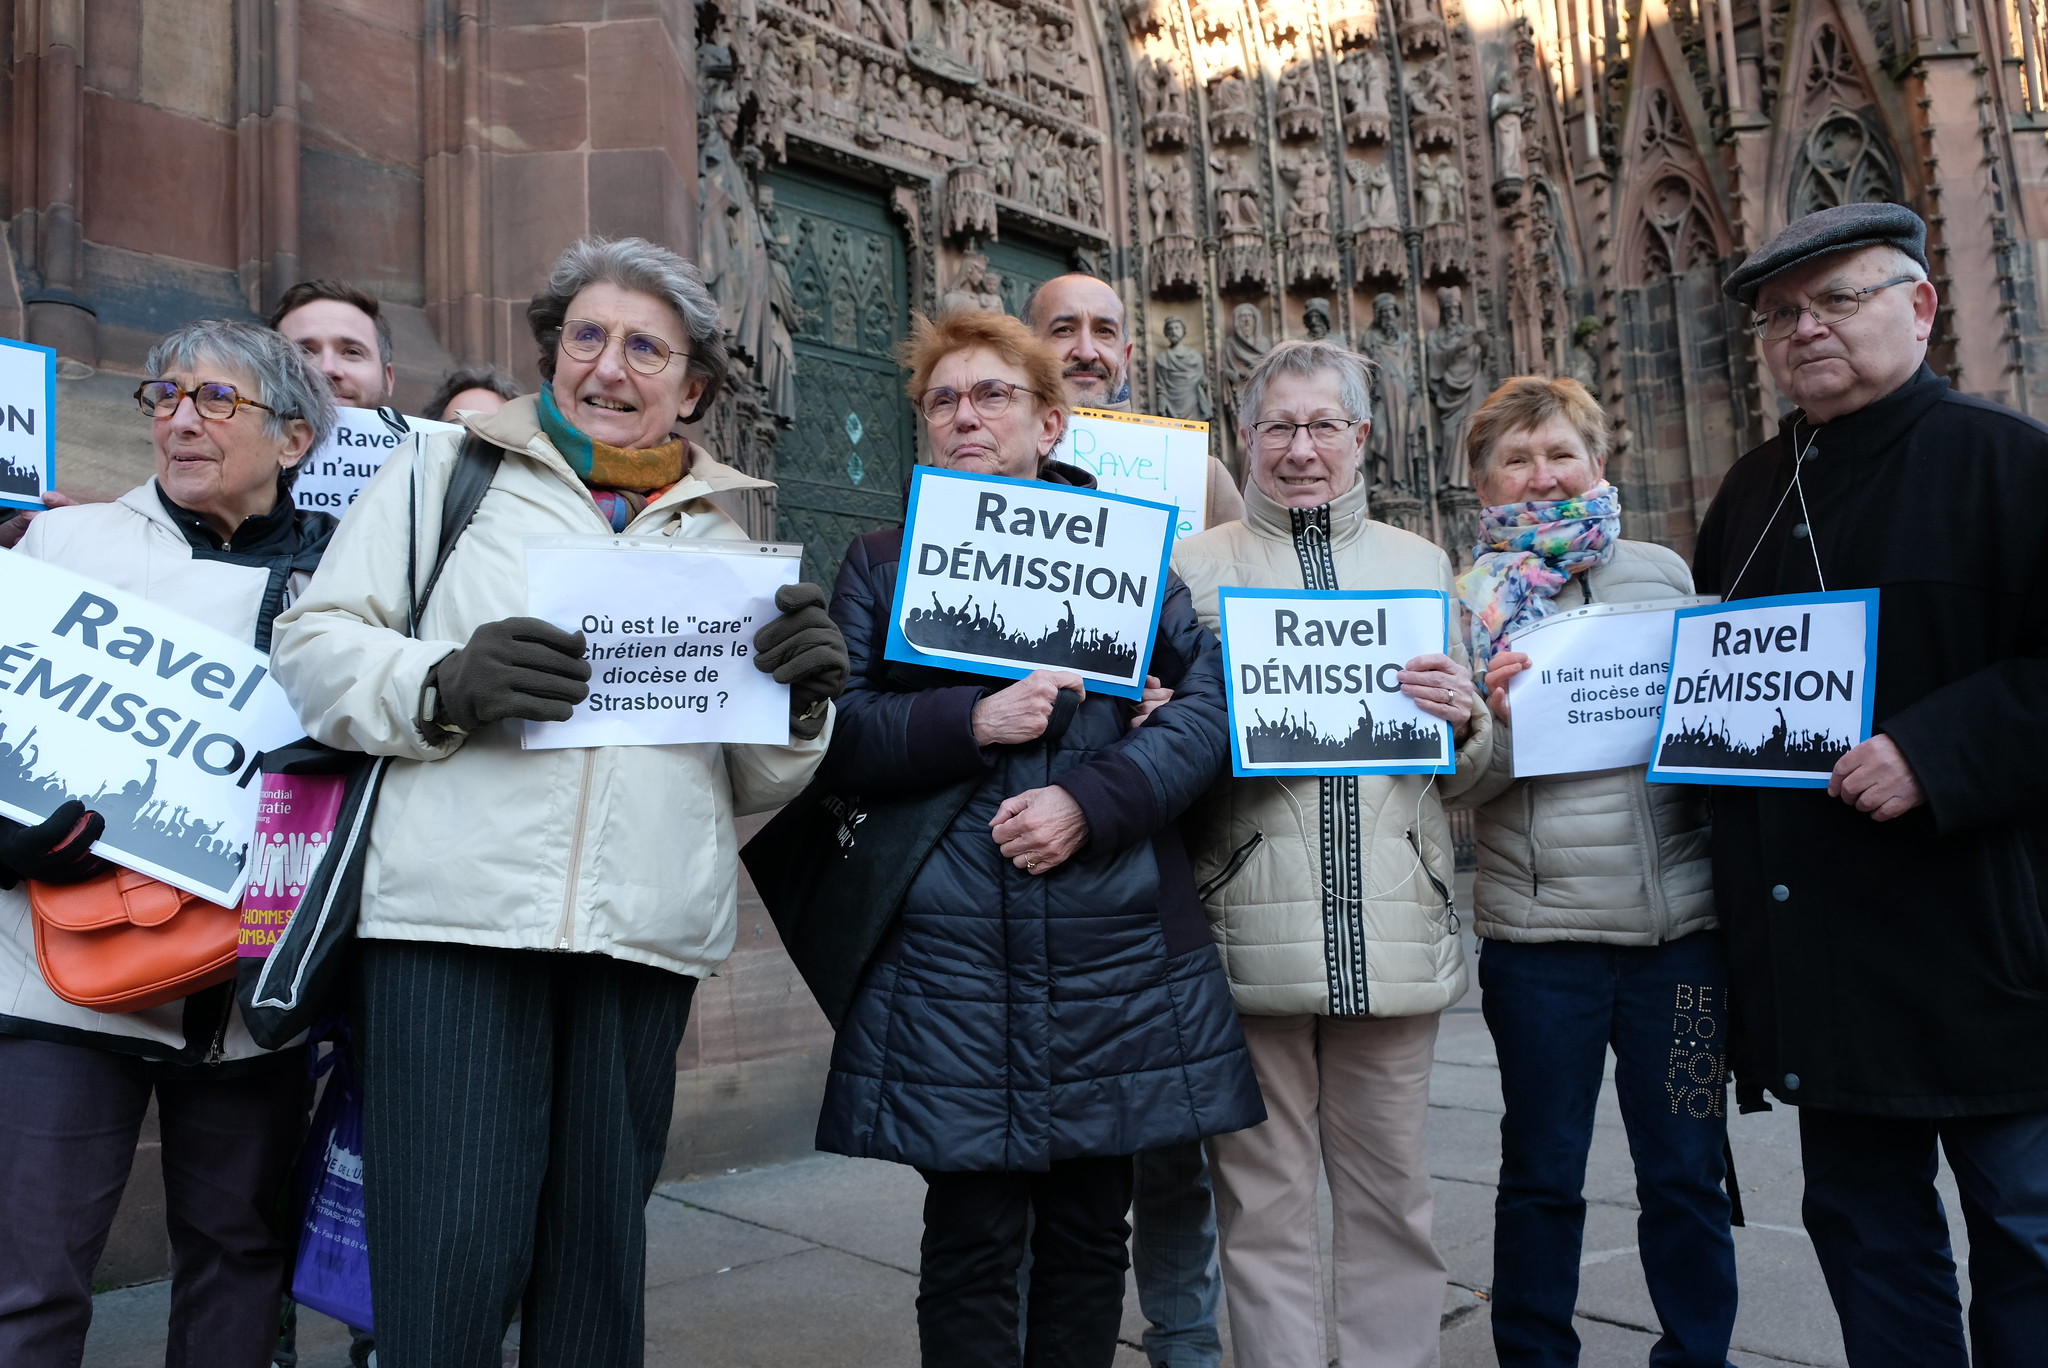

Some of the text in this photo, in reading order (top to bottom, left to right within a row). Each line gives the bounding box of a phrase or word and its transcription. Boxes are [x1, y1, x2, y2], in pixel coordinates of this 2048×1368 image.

[299, 491, 342, 507] nos
[975, 491, 1109, 548] Ravel
[917, 541, 1148, 608] DÉMISSION
[581, 615, 753, 635] Où est le "care"
[1274, 608, 1387, 647] Ravel
[1711, 612, 1811, 658] Ravel
[52, 591, 268, 713] Ravel
[673, 641, 724, 659] dans
[731, 641, 748, 657] le
[602, 666, 719, 685] diocèse de
[1240, 657, 1404, 695] DÉMISSIO
[1541, 660, 1670, 685] Il fait nuit dans
[1570, 681, 1666, 703] diocèse de
[1673, 670, 1855, 705] DÉMISSION
[588, 691, 729, 713] Strasbourg ?
[1675, 984, 1713, 1013] BE
[1673, 1013, 1716, 1039] DO
